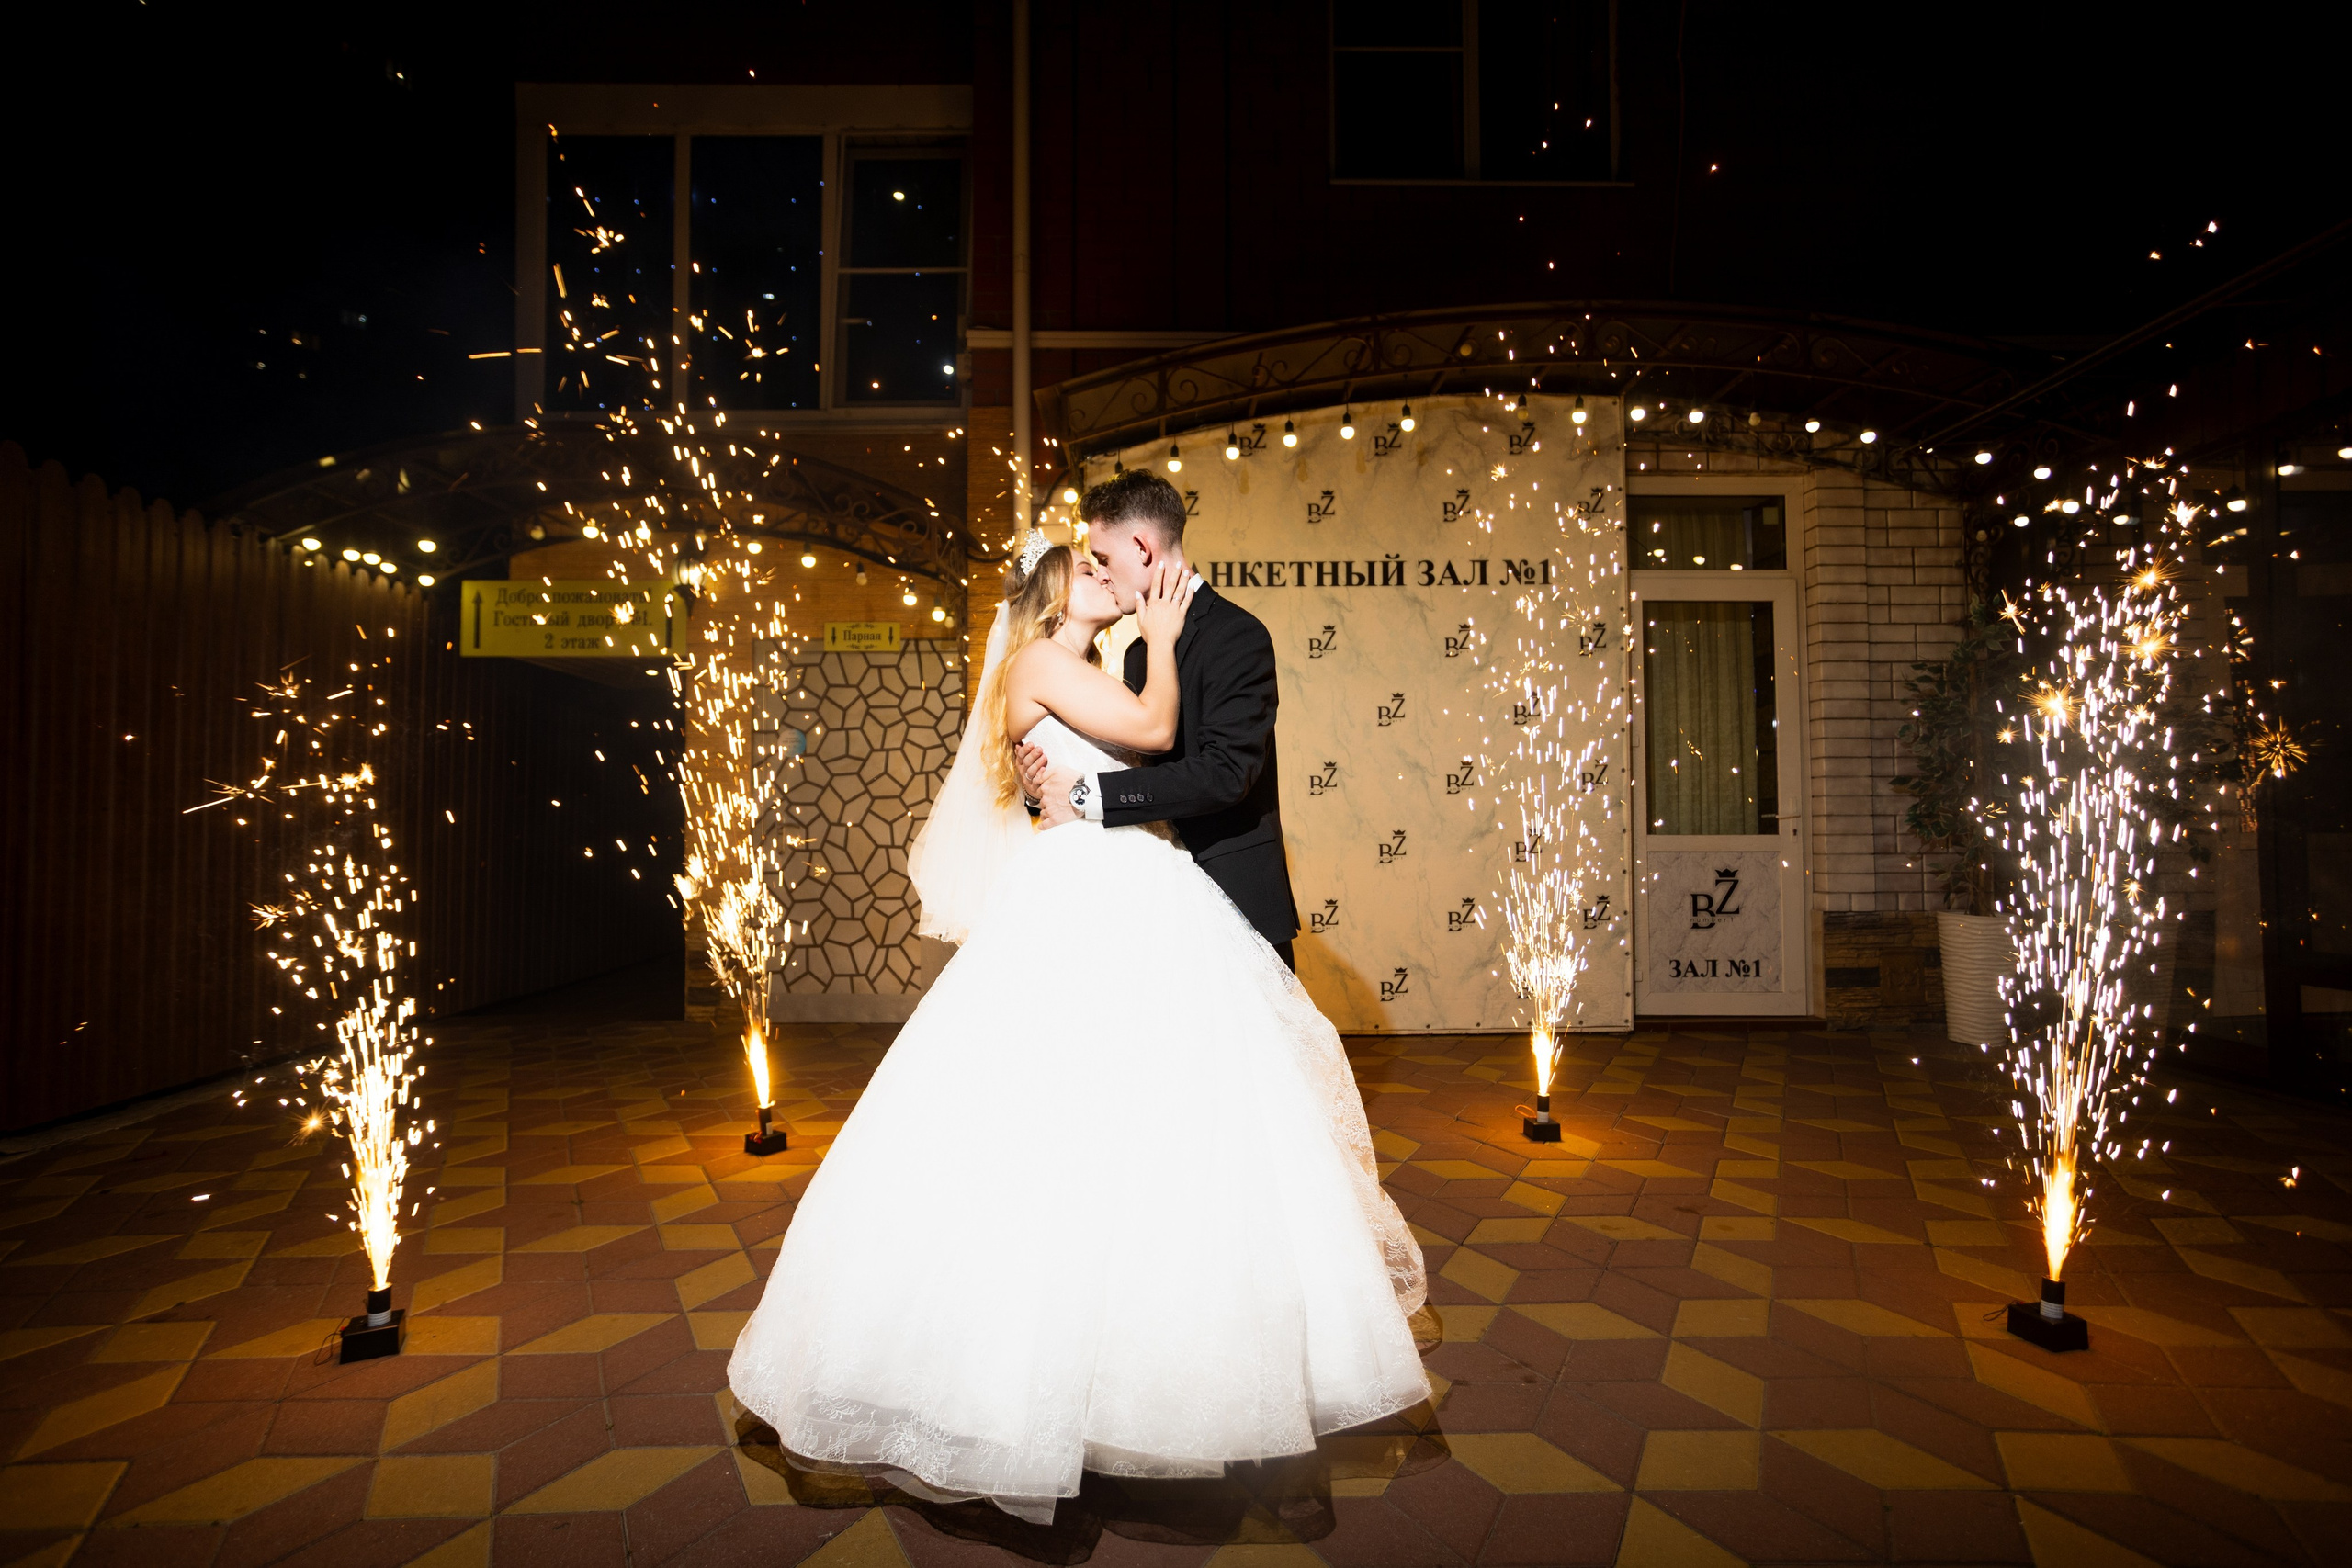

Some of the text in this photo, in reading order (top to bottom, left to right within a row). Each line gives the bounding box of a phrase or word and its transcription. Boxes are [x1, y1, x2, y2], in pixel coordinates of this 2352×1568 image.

[1417, 558, 1490, 587] ЗАЛ
[1499, 558, 1553, 587] №1
[495, 587, 546, 606] Добро
[544, 632, 600, 649] 2 этаж
[843, 629, 881, 642] Парная
[1690, 879, 1740, 930] BZ
[1669, 959, 1762, 978] ЗАЛ №1
